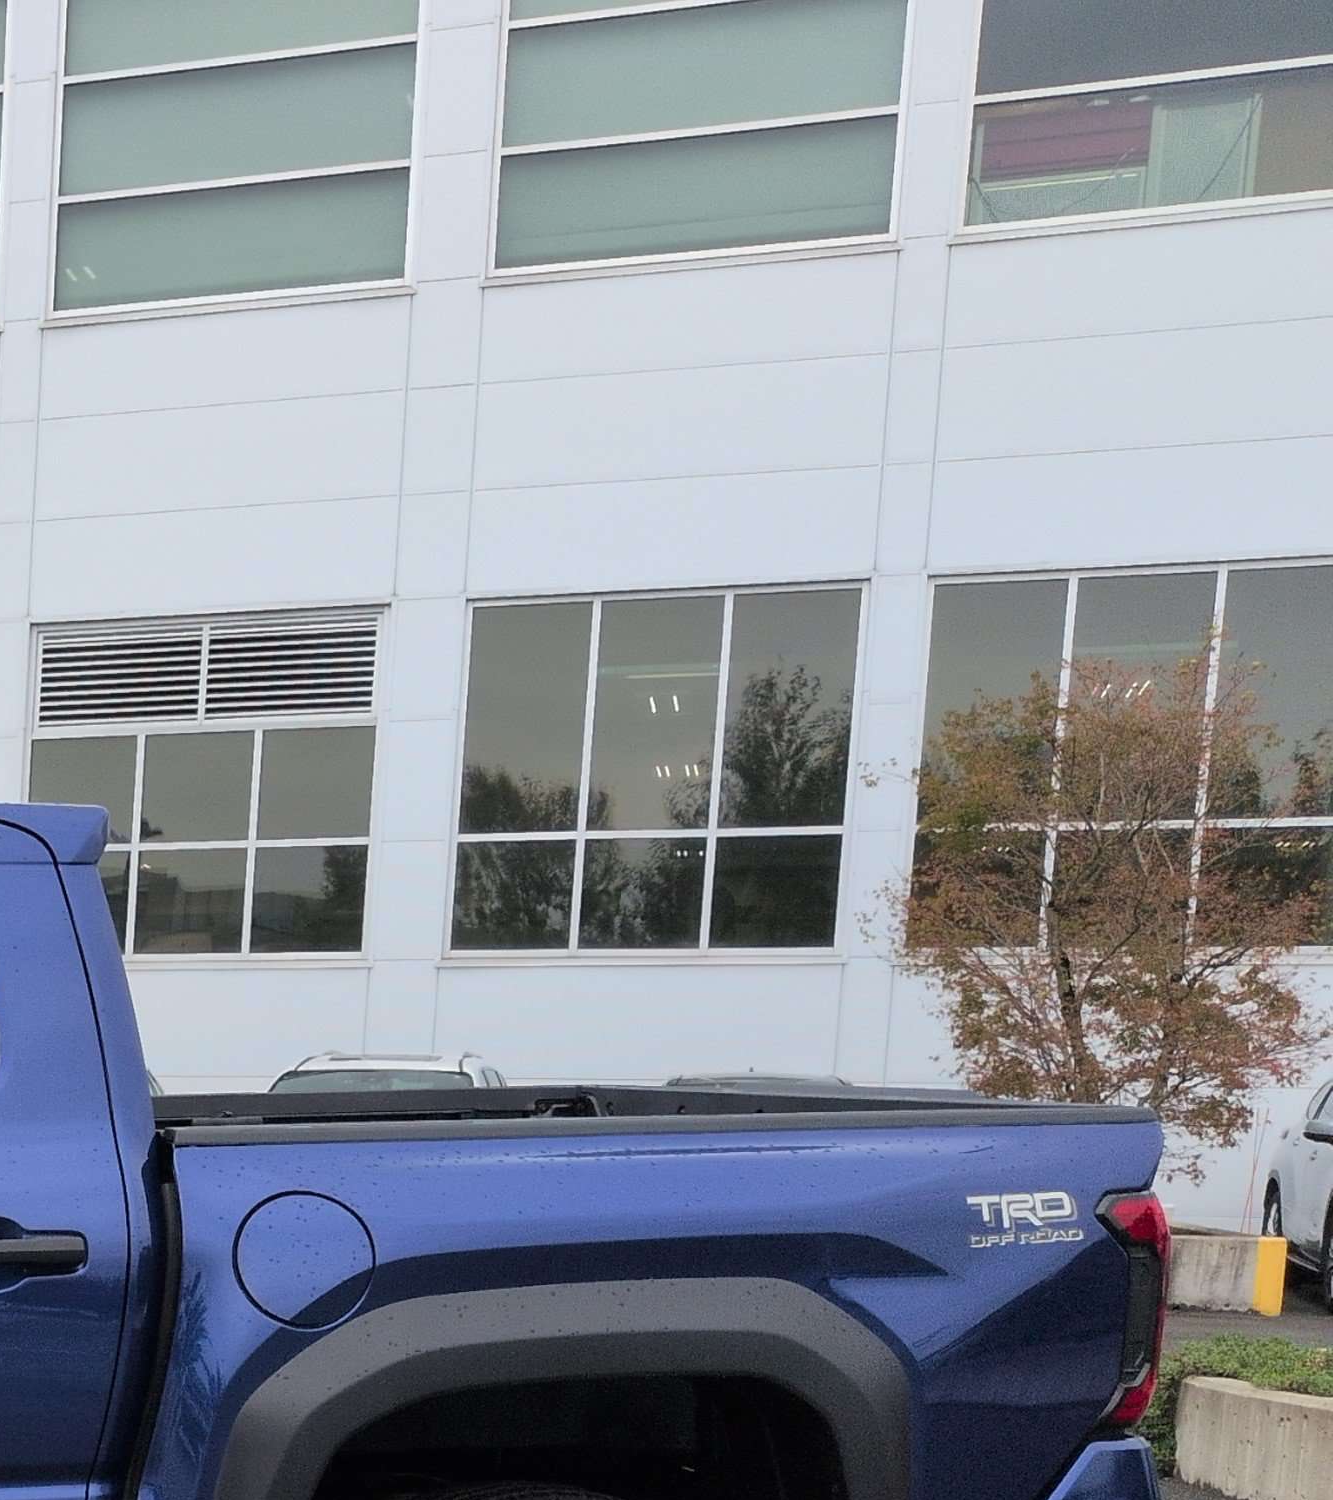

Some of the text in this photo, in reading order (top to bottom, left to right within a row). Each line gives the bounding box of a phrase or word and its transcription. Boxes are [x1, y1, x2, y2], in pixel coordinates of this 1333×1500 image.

[966, 1191, 1078, 1230] TRD
[969, 1228, 1085, 1248] OFF ROAD
